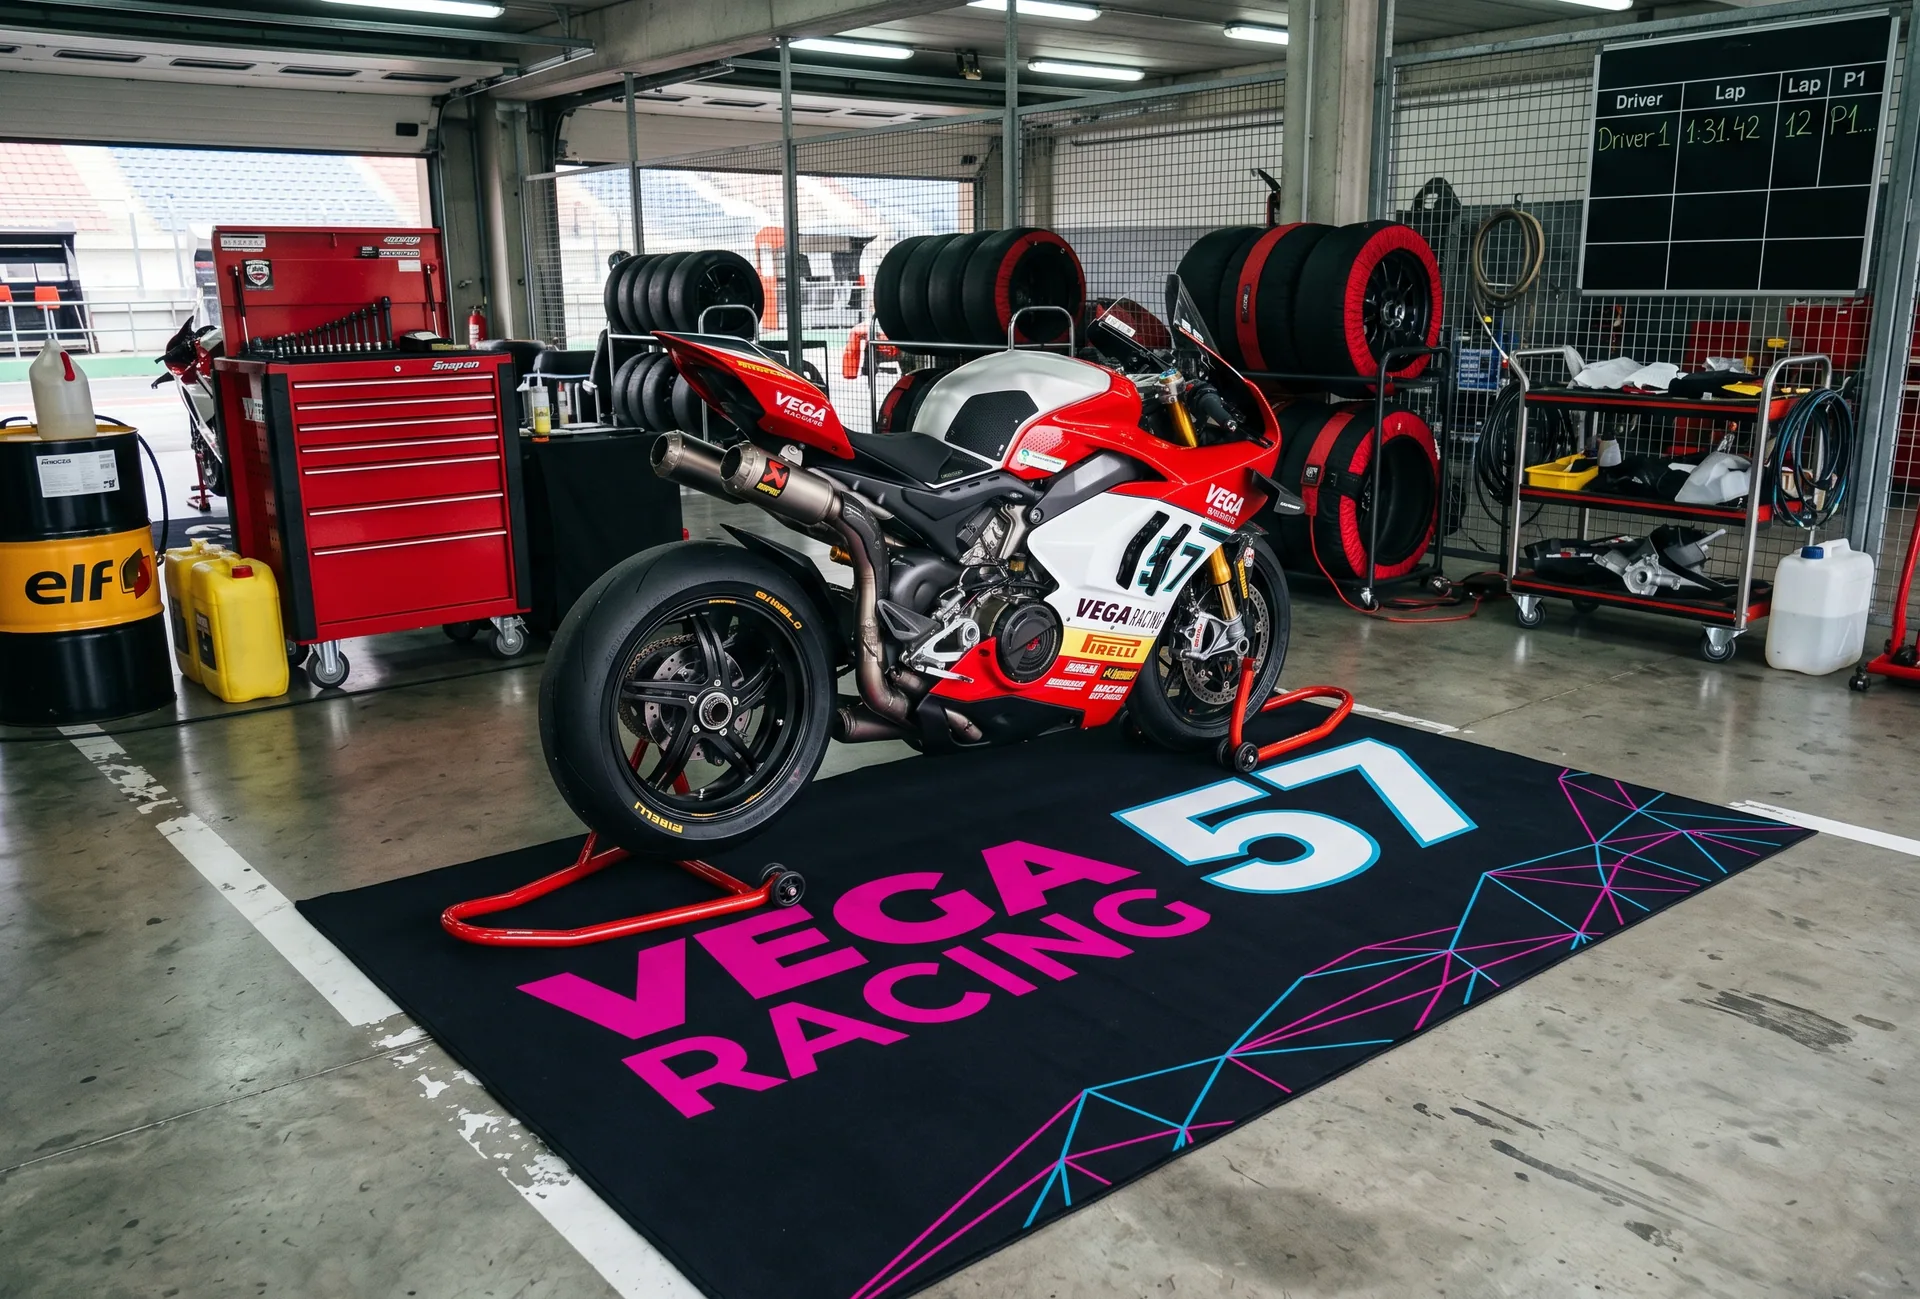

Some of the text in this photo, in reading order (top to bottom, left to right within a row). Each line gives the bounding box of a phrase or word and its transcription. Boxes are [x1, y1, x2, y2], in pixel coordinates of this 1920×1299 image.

[1616, 71, 1866, 110] Driver Lap Lap P1
[1686, 115, 1761, 144] 1:31.42
[1785, 109, 1812, 138] 12
[775, 391, 827, 422] VEGA
[1205, 483, 1245, 516] VEGA
[25, 559, 114, 605] elf
[1076, 598, 1165, 630] VEGA RACING
[1080, 633, 1142, 658] PIRELLI
[1112, 738, 1479, 896] 57
[517, 841, 1140, 1040] VEGA
[623, 889, 1211, 1119] RACING
